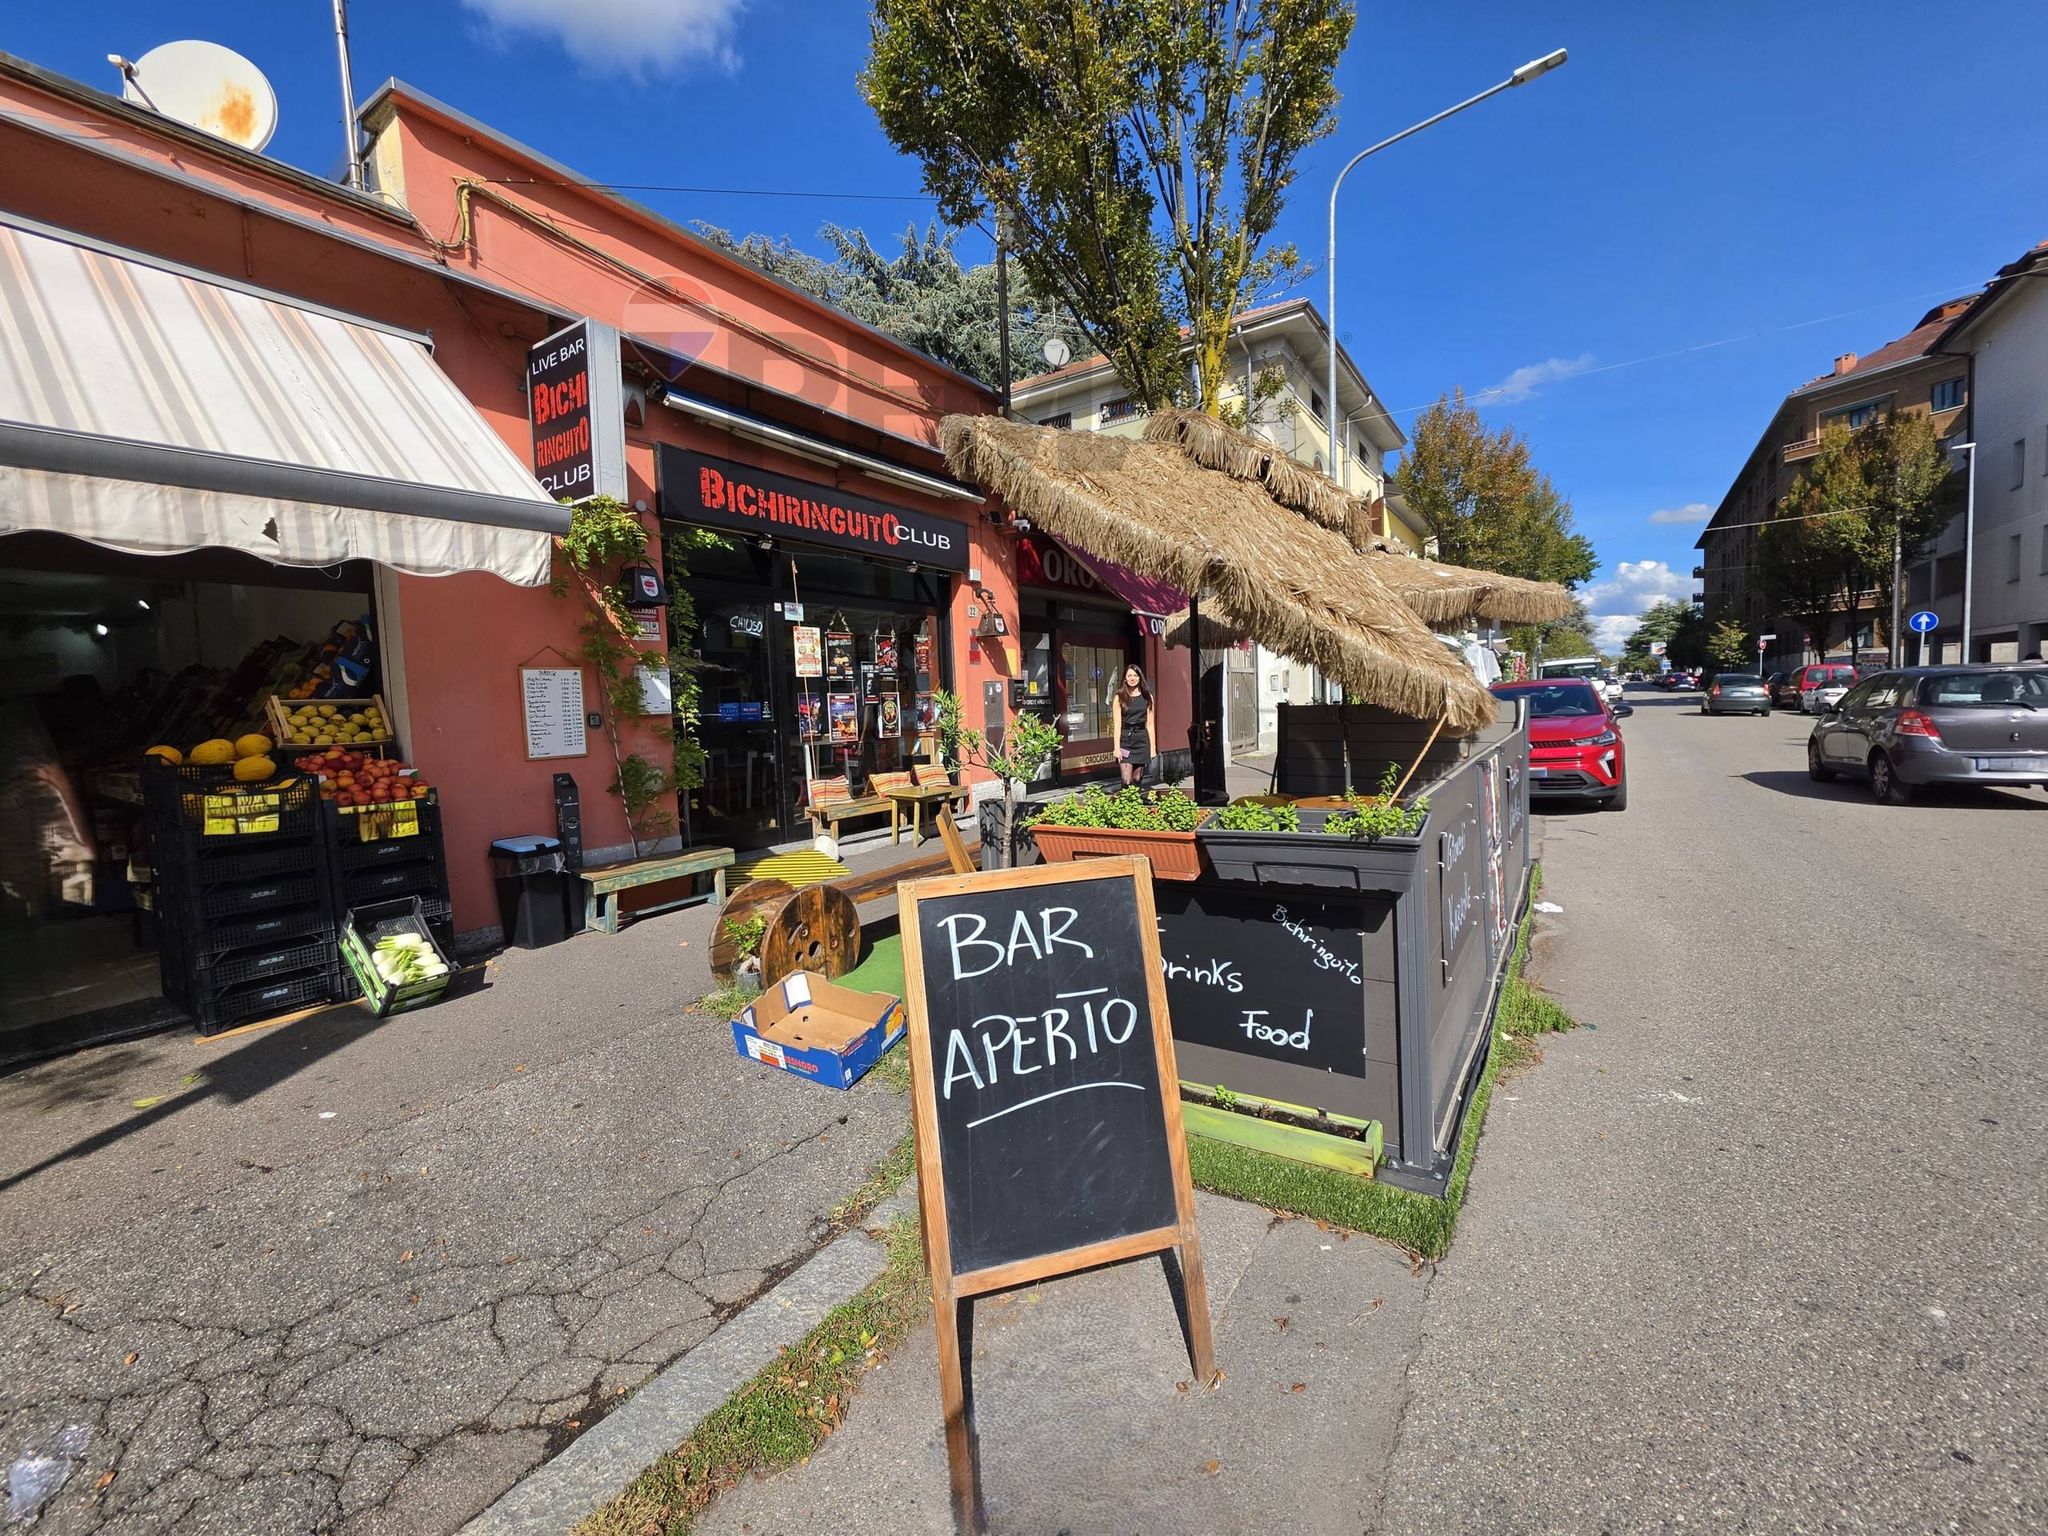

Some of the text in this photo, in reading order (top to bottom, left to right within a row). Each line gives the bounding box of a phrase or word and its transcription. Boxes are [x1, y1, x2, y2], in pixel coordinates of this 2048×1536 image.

[532, 338, 585, 375] LIVE BAR
[534, 371, 587, 425] BICHI
[537, 416, 589, 468] RINGUITO
[539, 463, 591, 493] CLUB
[699, 466, 951, 551] BICHIRINGUITO CLUB
[729, 615, 764, 633] CHIUSO
[937, 906, 1094, 981] BAR
[1272, 904, 1362, 985] Bichiringuito
[943, 986, 1138, 1100] APERTO
[1238, 1008, 1314, 1051] Food
